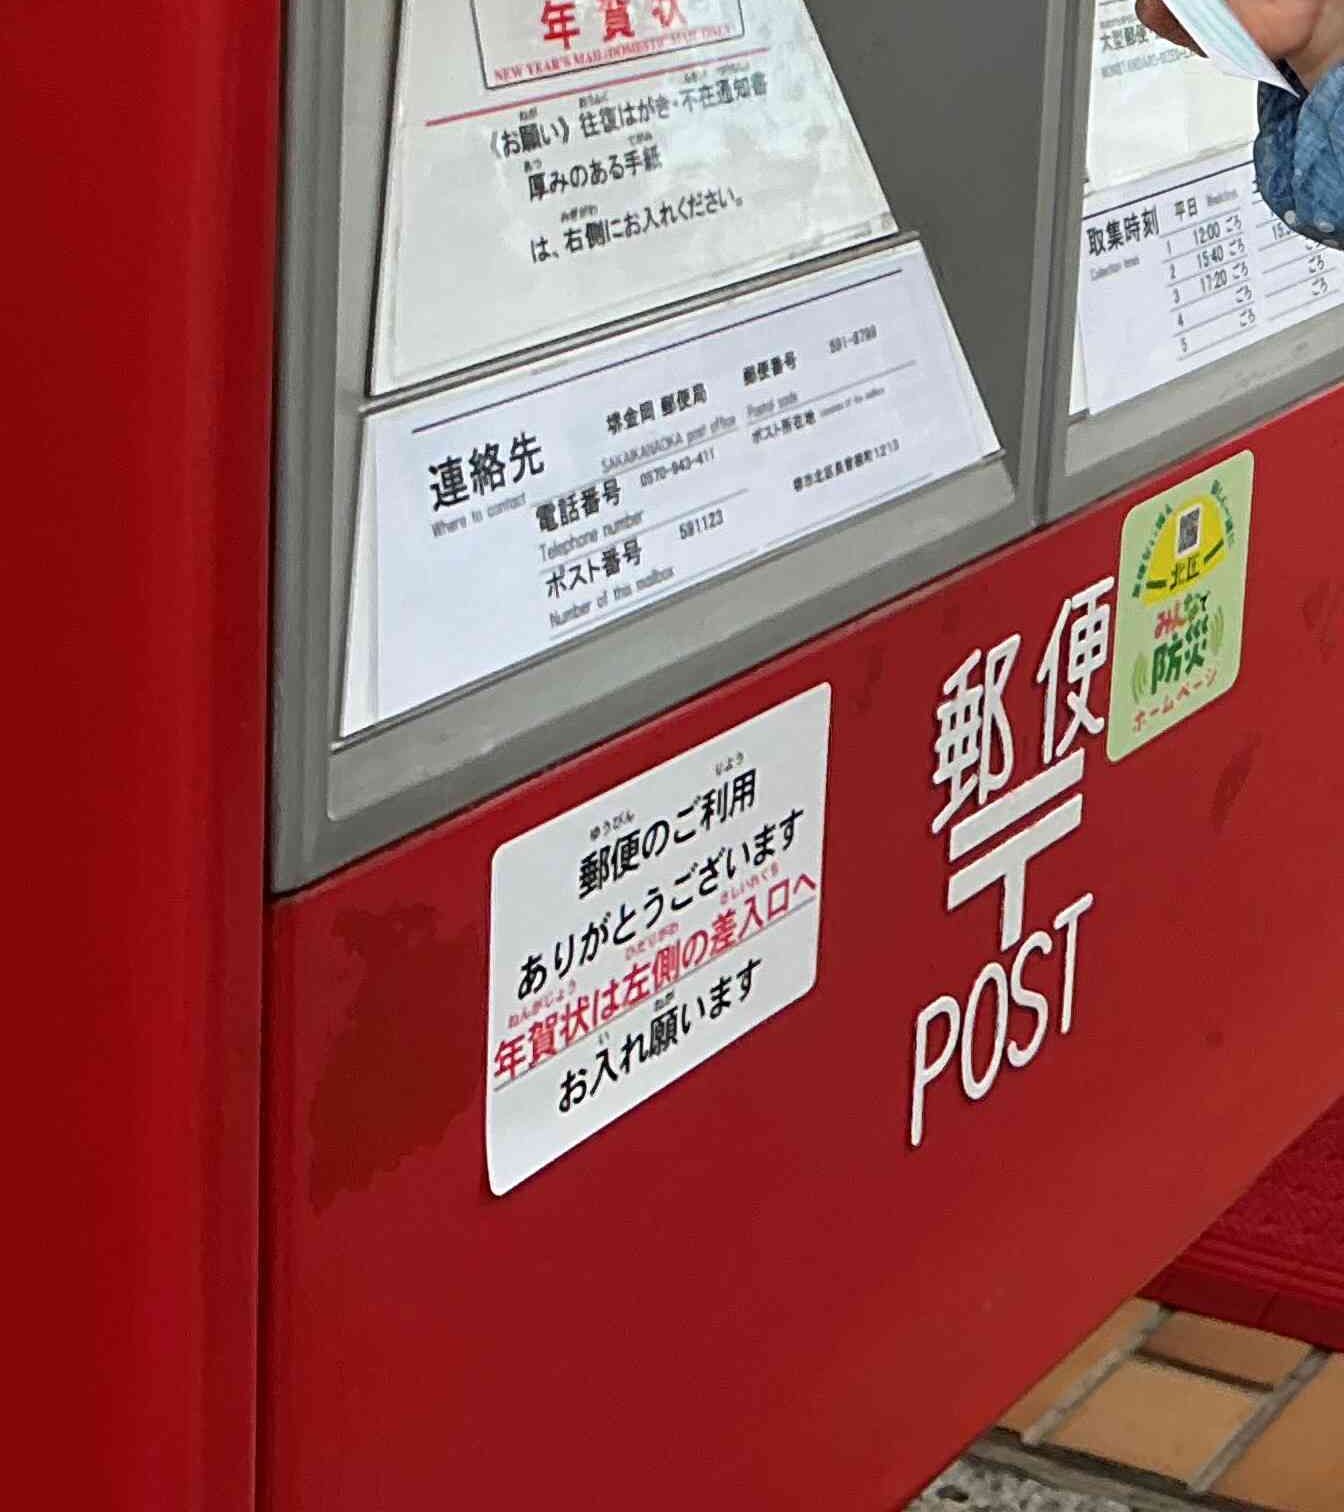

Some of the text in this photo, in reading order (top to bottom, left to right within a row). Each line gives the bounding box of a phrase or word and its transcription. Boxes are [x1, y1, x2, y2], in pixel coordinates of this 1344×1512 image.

[494, 65, 522, 82] NEW
[528, 145, 663, 201] 厚みのある手紙
[1087, 205, 1159, 256] 取集時刻
[1174, 197, 1198, 222] 平日
[743, 350, 797, 387] 郵便番号
[428, 431, 545, 512] 連絡先
[536, 477, 622, 533] 電話番号
[545, 536, 643, 599] ポスト番号
[1151, 614, 1209, 696] 防災
[931, 575, 1115, 834] 郵便
[1133, 668, 1217, 732] ホームページ
[577, 767, 757, 900] 郵便のご利用
[518, 808, 805, 1000] ありがとうございます
[493, 873, 817, 1081] 年賀状は左側の差入口へ
[558, 957, 763, 1113] お入れ願います
[909, 891, 1095, 1147] POST
